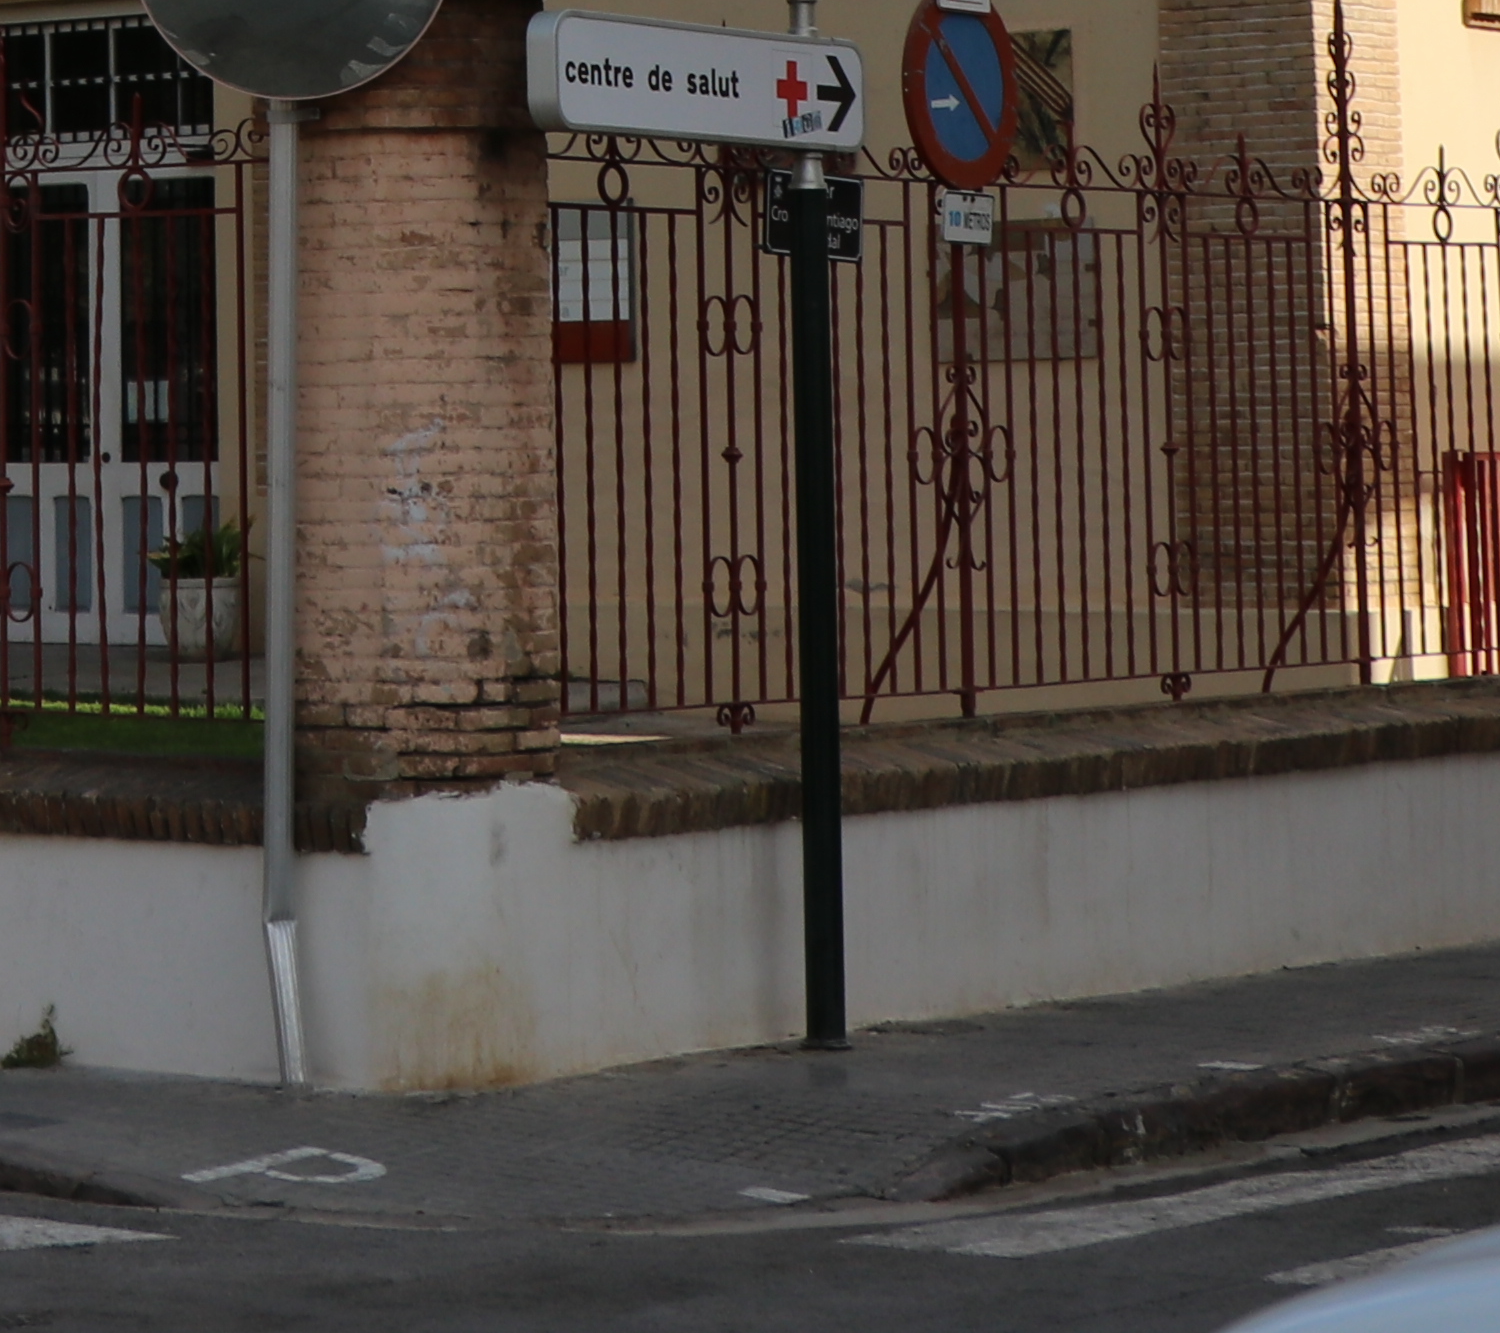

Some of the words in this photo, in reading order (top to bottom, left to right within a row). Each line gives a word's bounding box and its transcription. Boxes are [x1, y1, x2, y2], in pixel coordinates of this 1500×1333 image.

[565, 58, 634, 88] centre
[648, 64, 673, 92] de
[687, 68, 740, 99] salut
[826, 213, 859, 234] ntiago
[949, 211, 961, 226] 10
[963, 211, 990, 231] METROS
